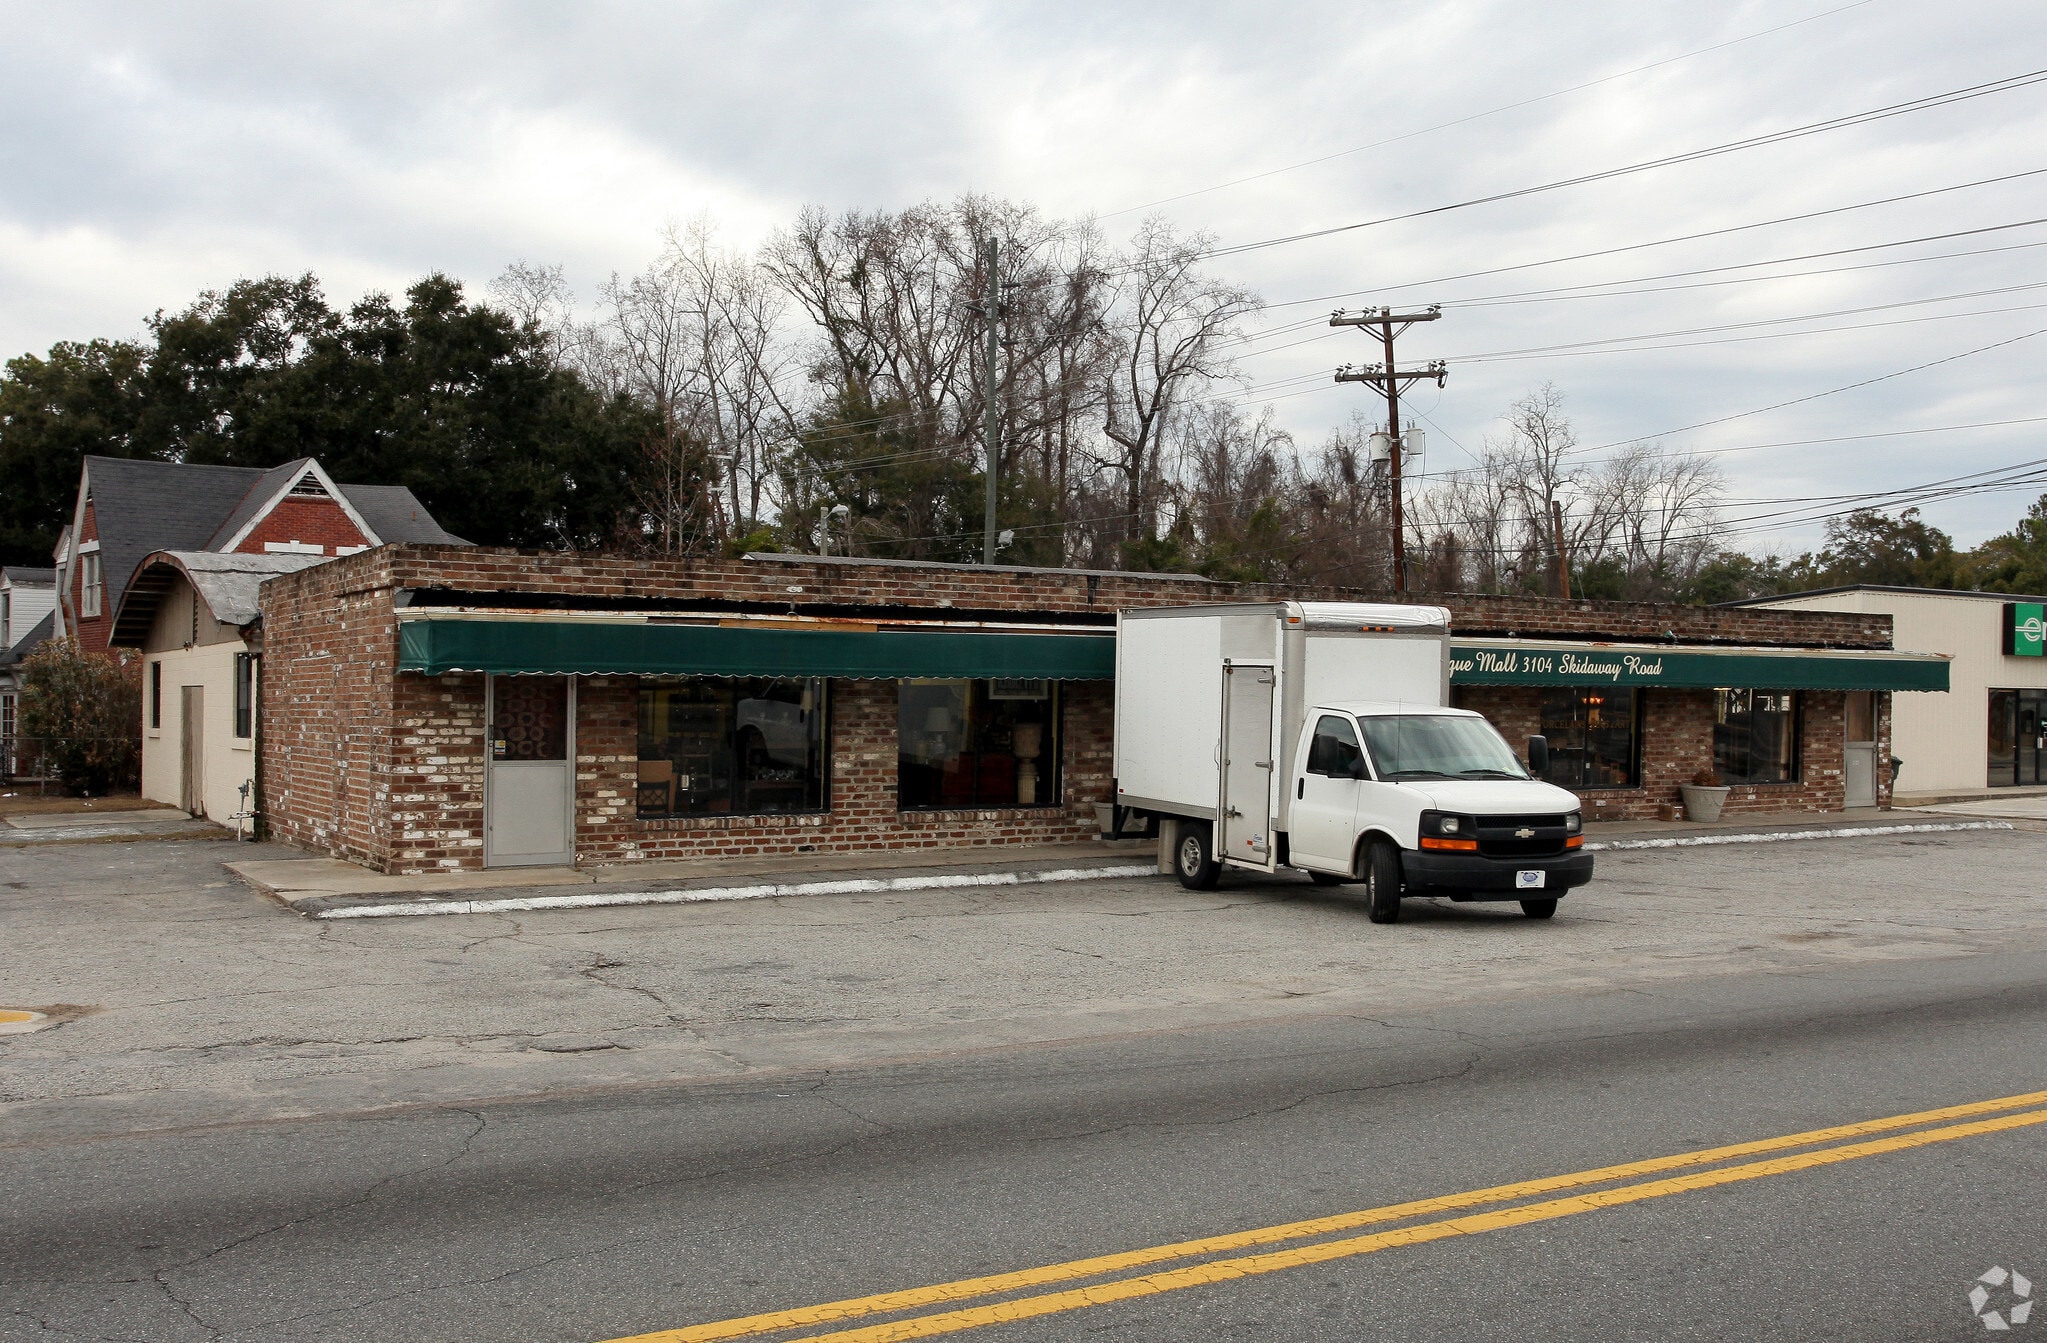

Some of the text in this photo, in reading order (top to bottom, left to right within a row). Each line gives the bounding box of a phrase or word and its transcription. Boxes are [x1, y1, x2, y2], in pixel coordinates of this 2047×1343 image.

[1476, 651, 1518, 673] Mall
[1522, 656, 1553, 673] 3104
[1558, 653, 1622, 682] Skidaway
[1623, 655, 1663, 675] Road
